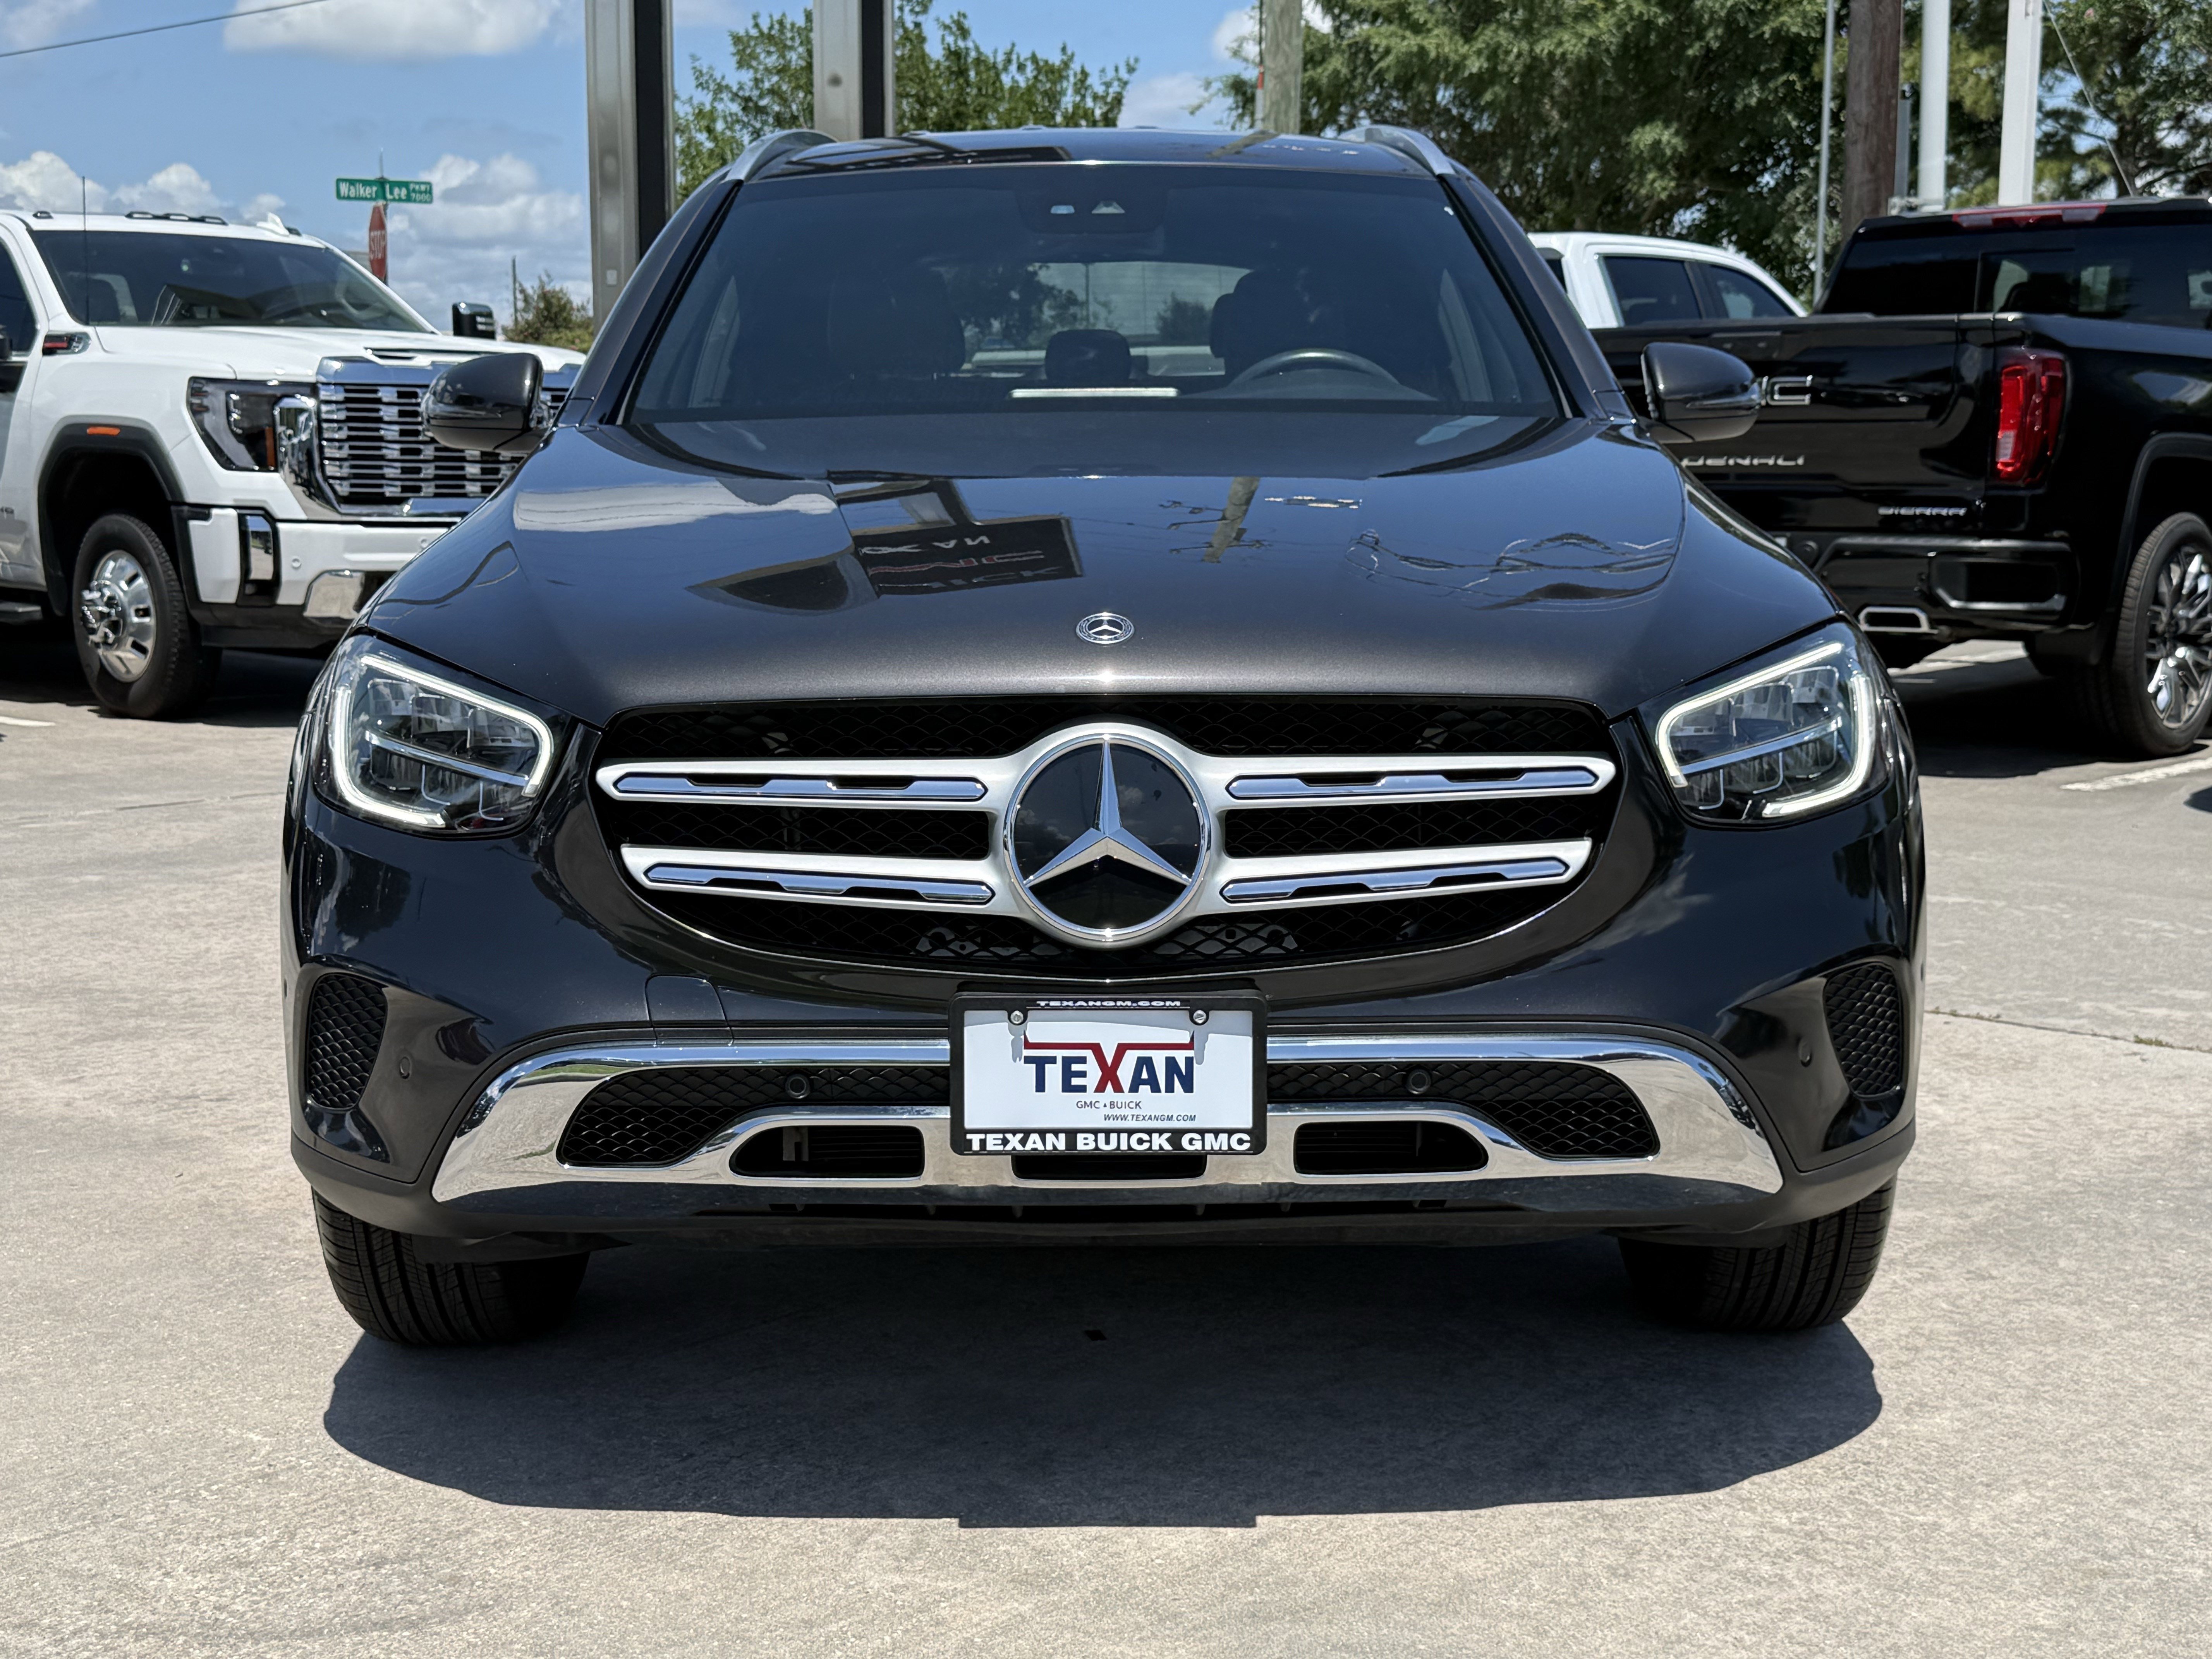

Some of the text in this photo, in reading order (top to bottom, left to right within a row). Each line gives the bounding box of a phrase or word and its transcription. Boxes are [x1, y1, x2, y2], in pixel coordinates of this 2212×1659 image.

[340, 182, 407, 199] Walker Lee
[1878, 507, 1967, 516] SIERRA
[1024, 1030, 1194, 1093] TEXAN
[1076, 1101, 1142, 1109] GMC BUICK
[1104, 1114, 1196, 1122] WWW.TEXANGM.COM
[966, 1133, 1251, 1151] TEXAN BUICK GMC
